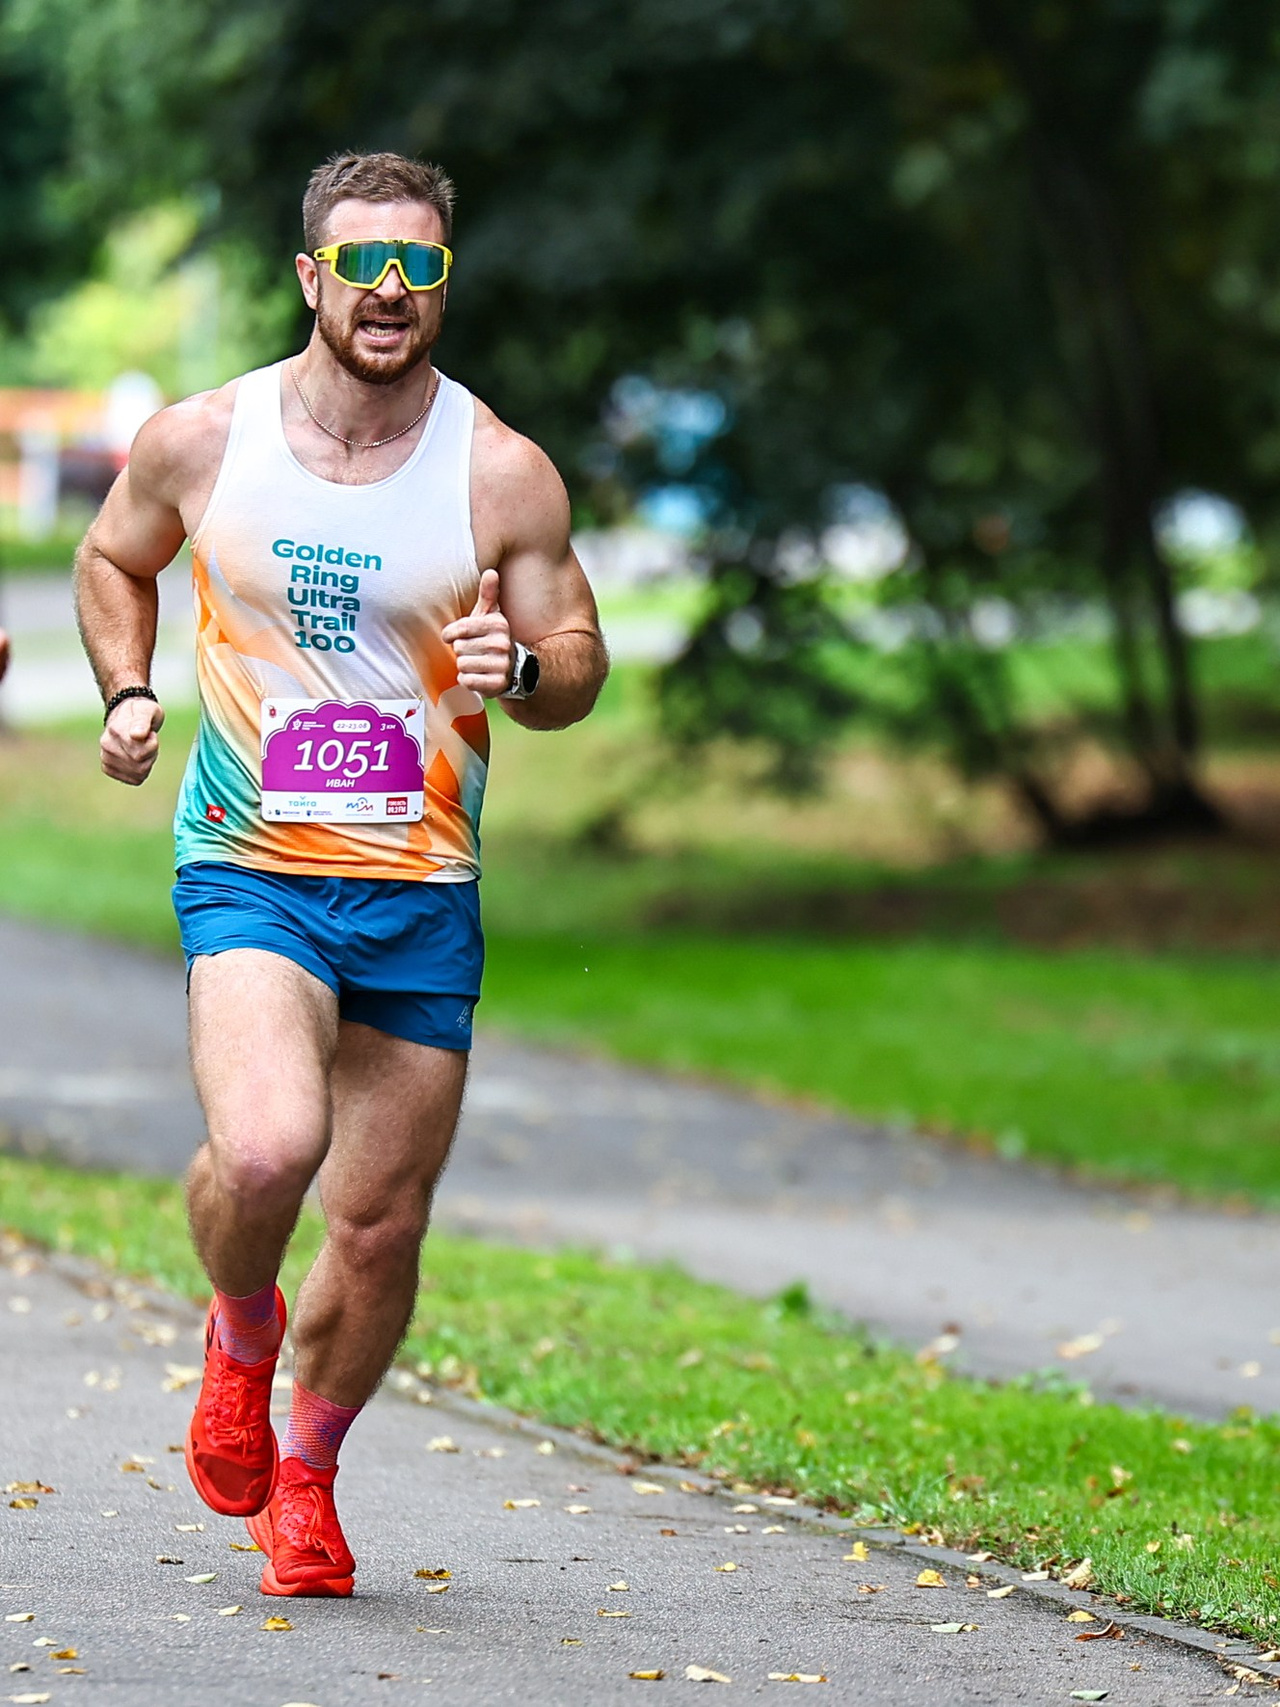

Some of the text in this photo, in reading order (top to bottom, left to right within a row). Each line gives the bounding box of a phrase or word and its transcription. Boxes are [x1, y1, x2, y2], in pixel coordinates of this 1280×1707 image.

[272, 538, 382, 571] Golden
[290, 564, 360, 594] Ring
[287, 587, 361, 612] Ultra
[290, 609, 356, 632] Trail
[294, 630, 356, 653] 100
[336, 722, 368, 730] 22-23.08
[293, 739, 390, 778] 1051
[325, 779, 356, 788] ИВАН
